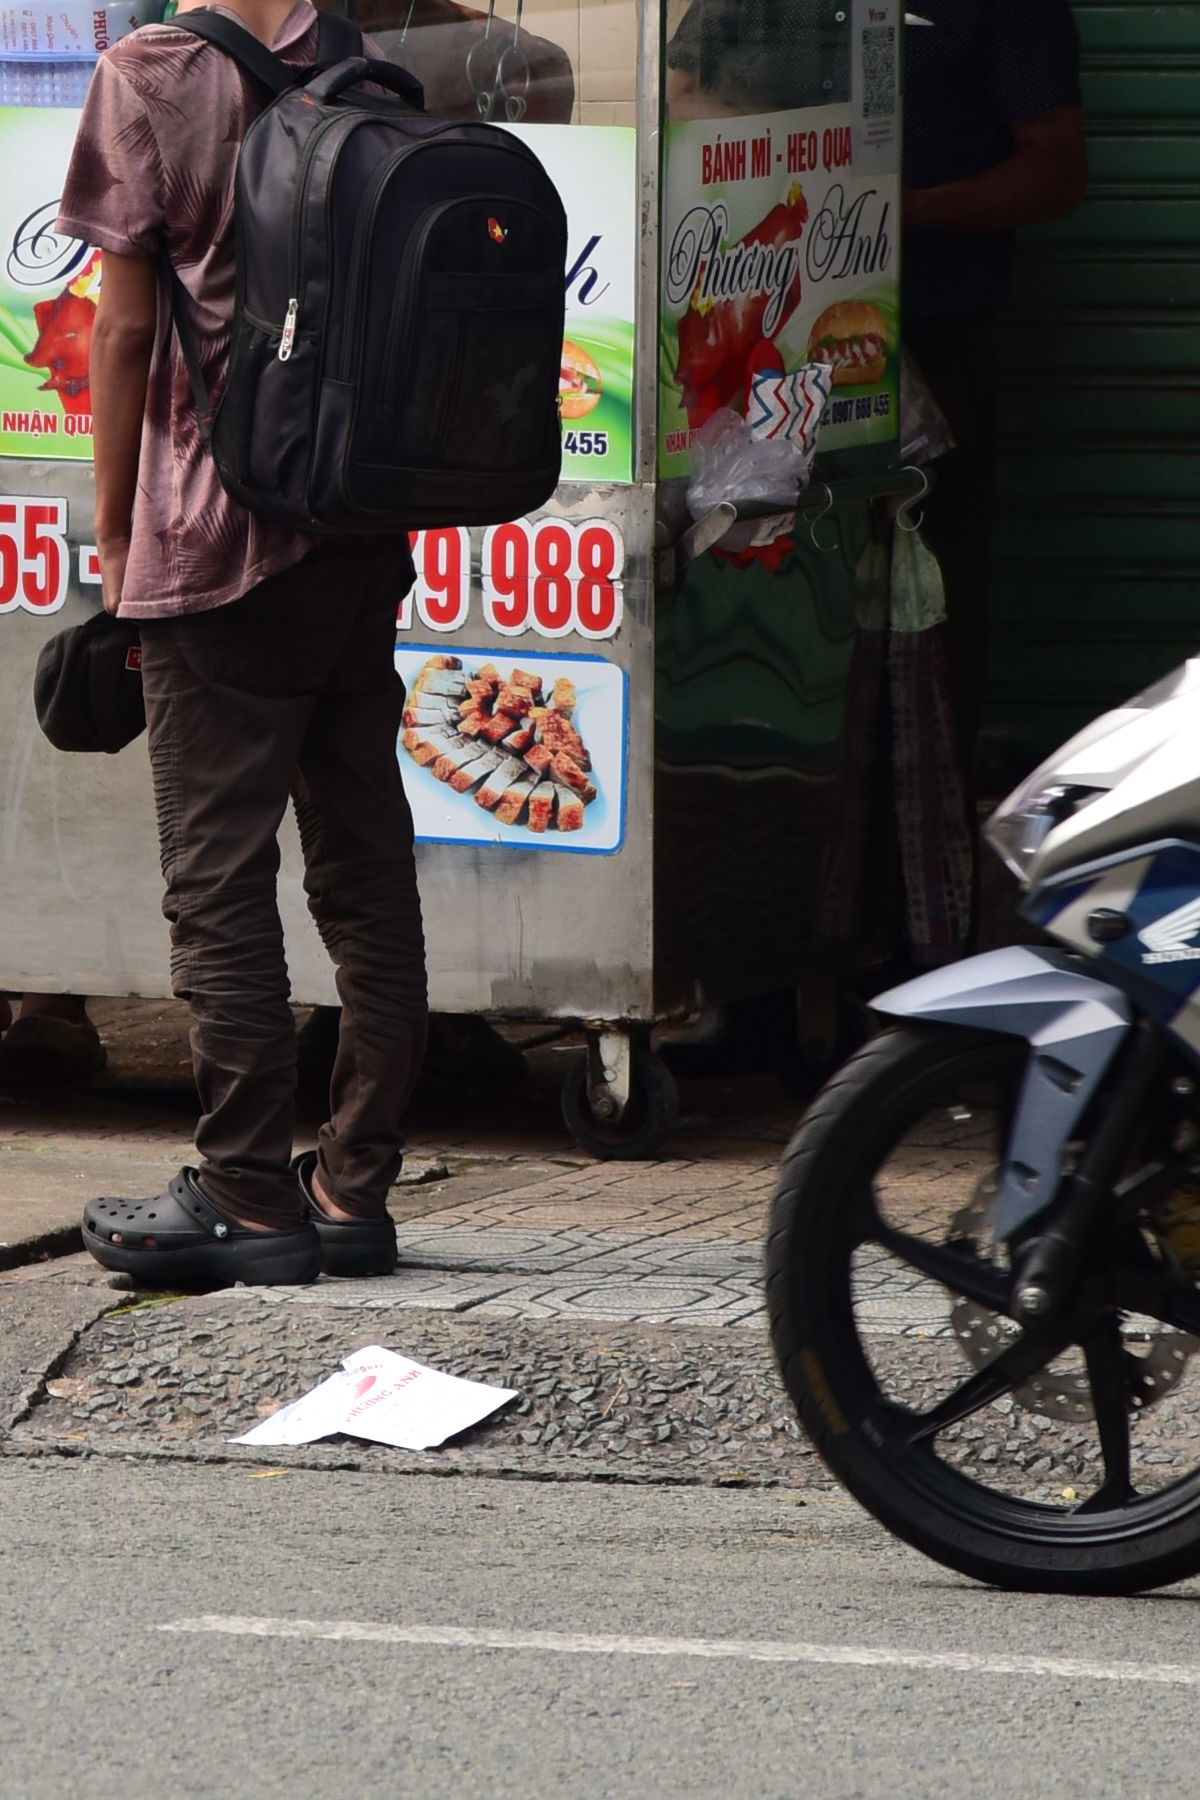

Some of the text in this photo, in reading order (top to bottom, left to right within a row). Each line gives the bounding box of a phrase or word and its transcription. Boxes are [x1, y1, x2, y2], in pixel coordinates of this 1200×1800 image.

[702, 134, 746, 184] BÁNH
[751, 128, 771, 179] MÌ
[787, 130, 817, 174] HEO
[667, 204, 795, 332] Phương
[806, 184, 892, 282] Anh
[2, 410, 57, 437] NHẬN
[832, 401, 853, 423] 0907
[873, 394, 889, 416] 455
[564, 432, 607, 455] 455
[397, 526, 461, 625] 9
[491, 522, 615, 632] 988
